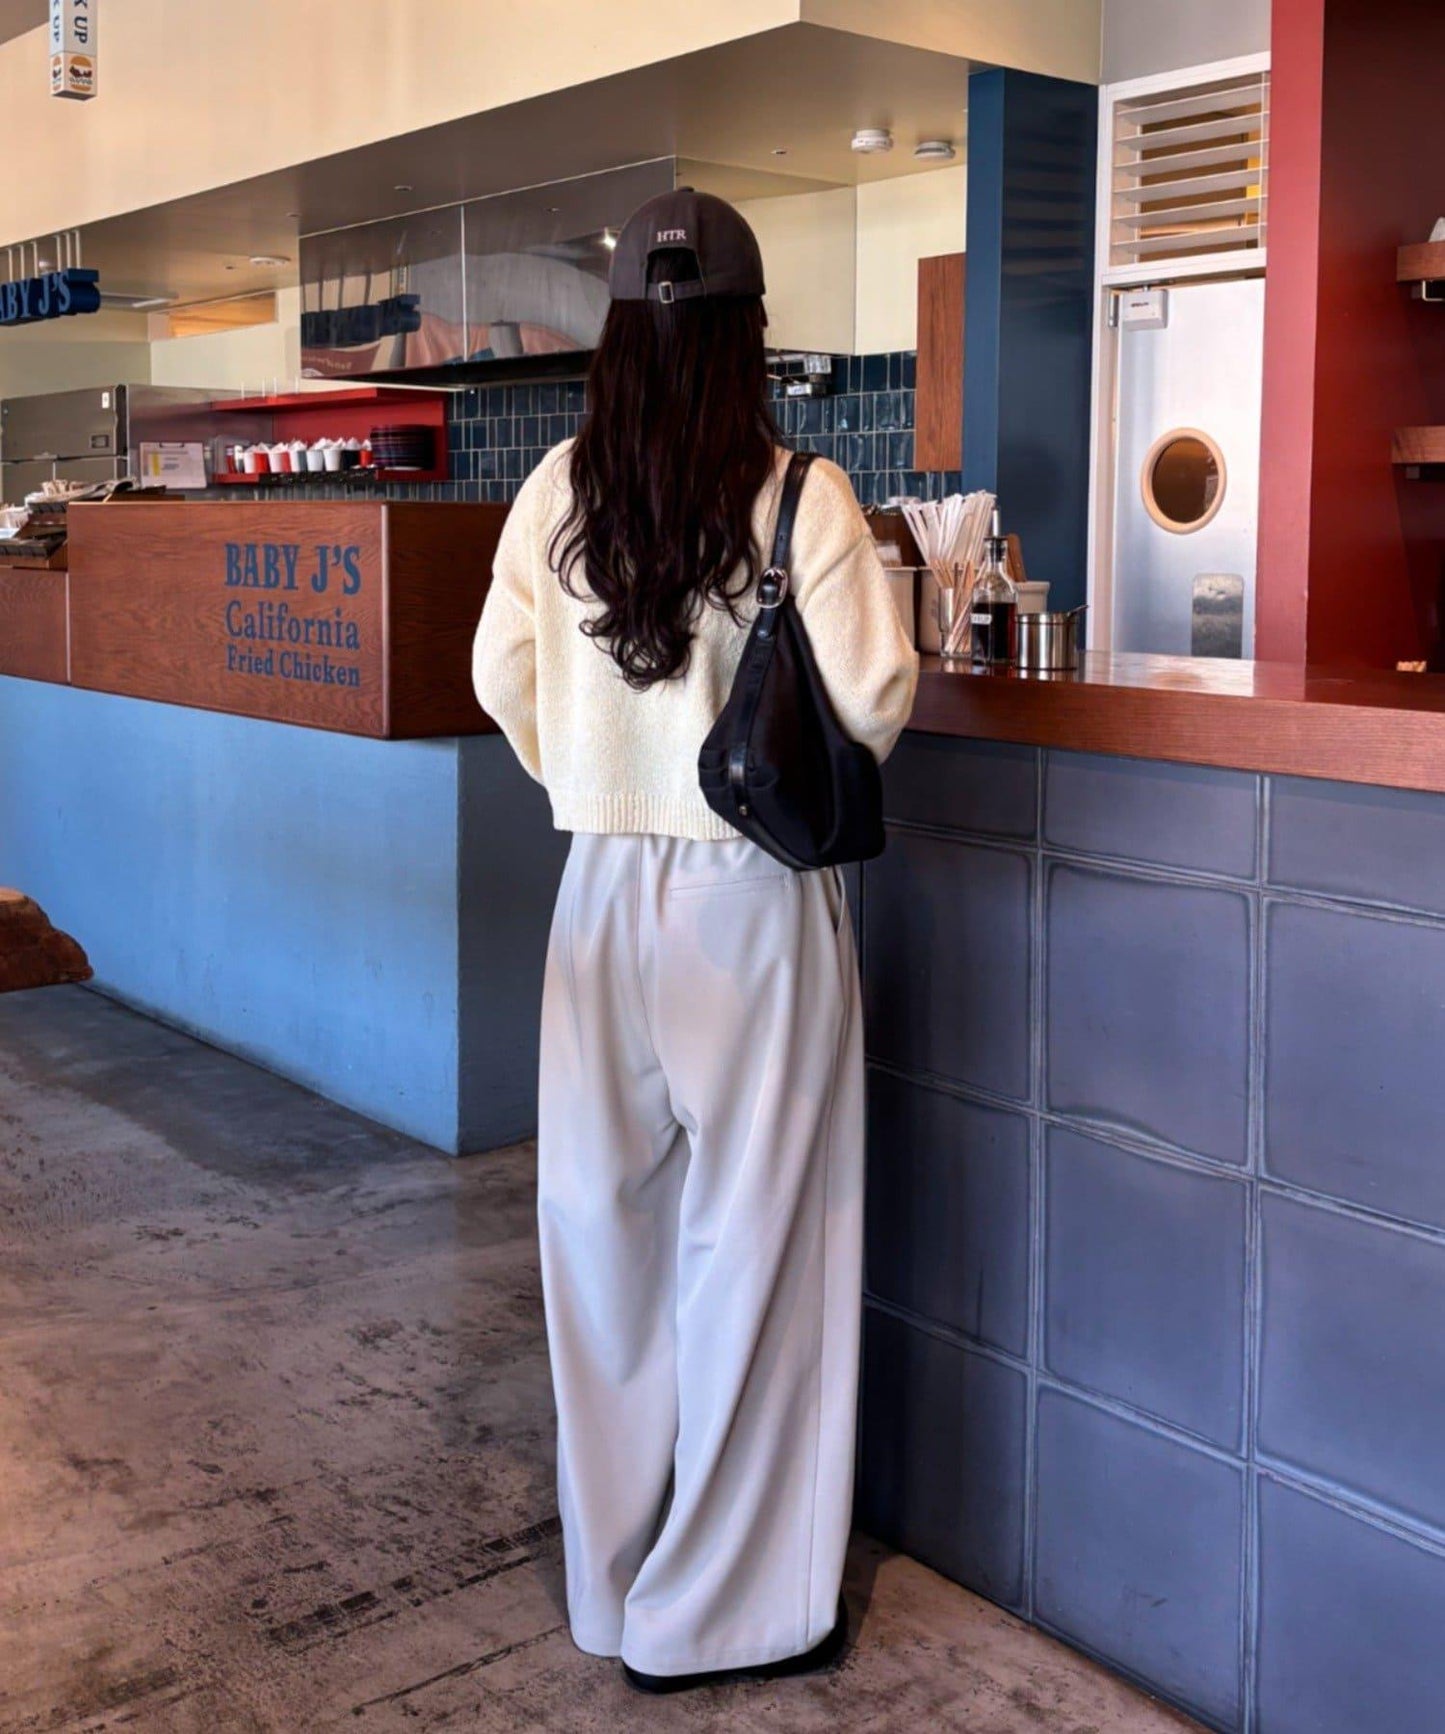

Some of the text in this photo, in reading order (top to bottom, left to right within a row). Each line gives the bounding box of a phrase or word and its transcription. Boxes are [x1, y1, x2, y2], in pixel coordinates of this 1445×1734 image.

[74, 16, 88, 44] UP
[656, 229, 687, 242] HTR
[38, 271, 71, 315] J'S
[225, 543, 361, 595] BABY J'S
[226, 600, 360, 650] California
[227, 644, 360, 687] Fried Chicken
